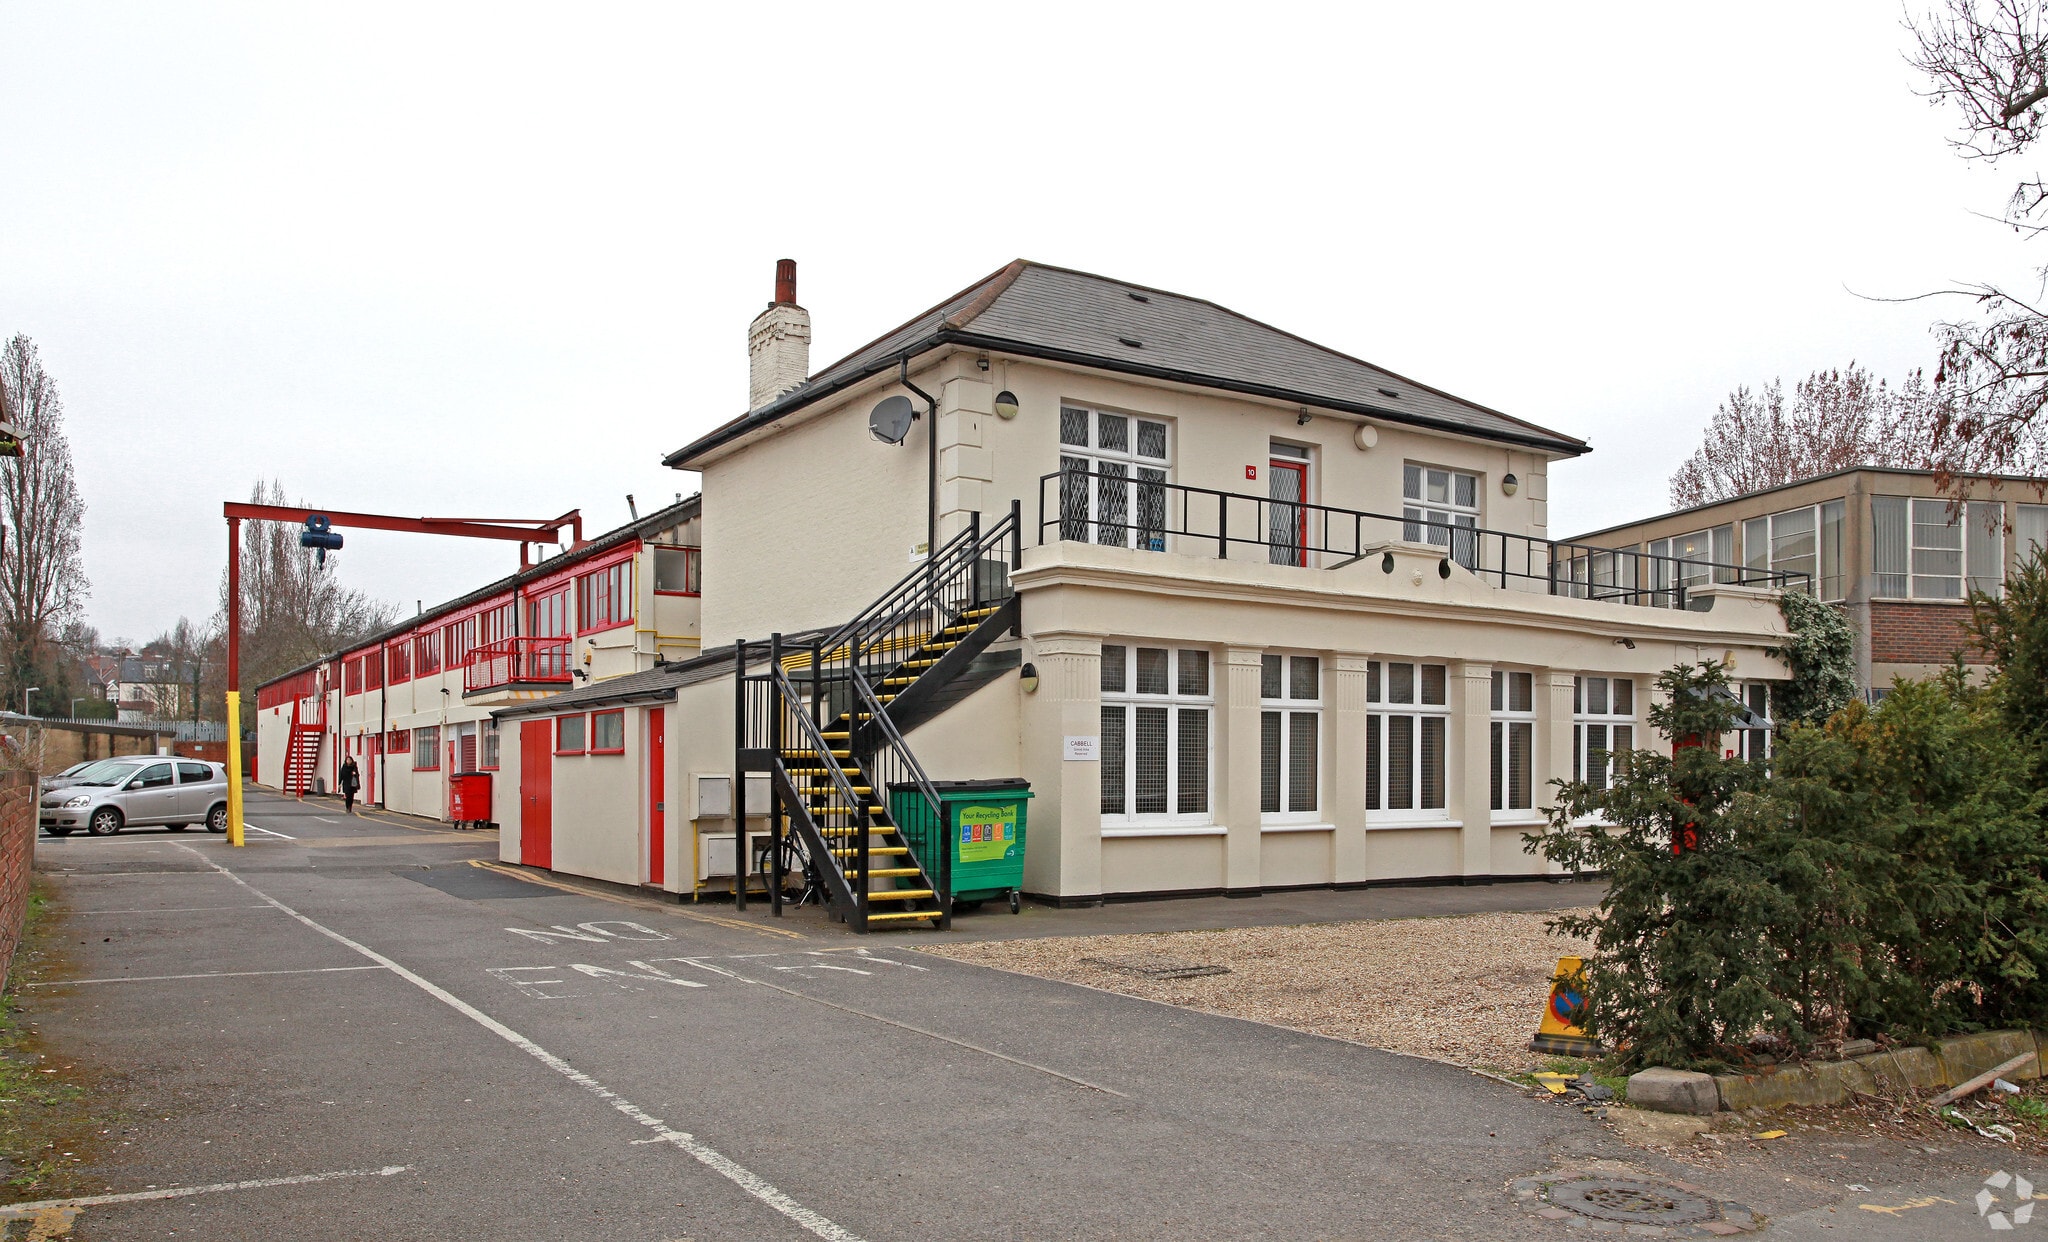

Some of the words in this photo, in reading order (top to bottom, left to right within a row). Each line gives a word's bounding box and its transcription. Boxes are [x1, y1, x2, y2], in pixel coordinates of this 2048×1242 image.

[976, 811, 1000, 820] Recycling
[1001, 809, 1014, 817] Bank
[504, 920, 677, 945] NO
